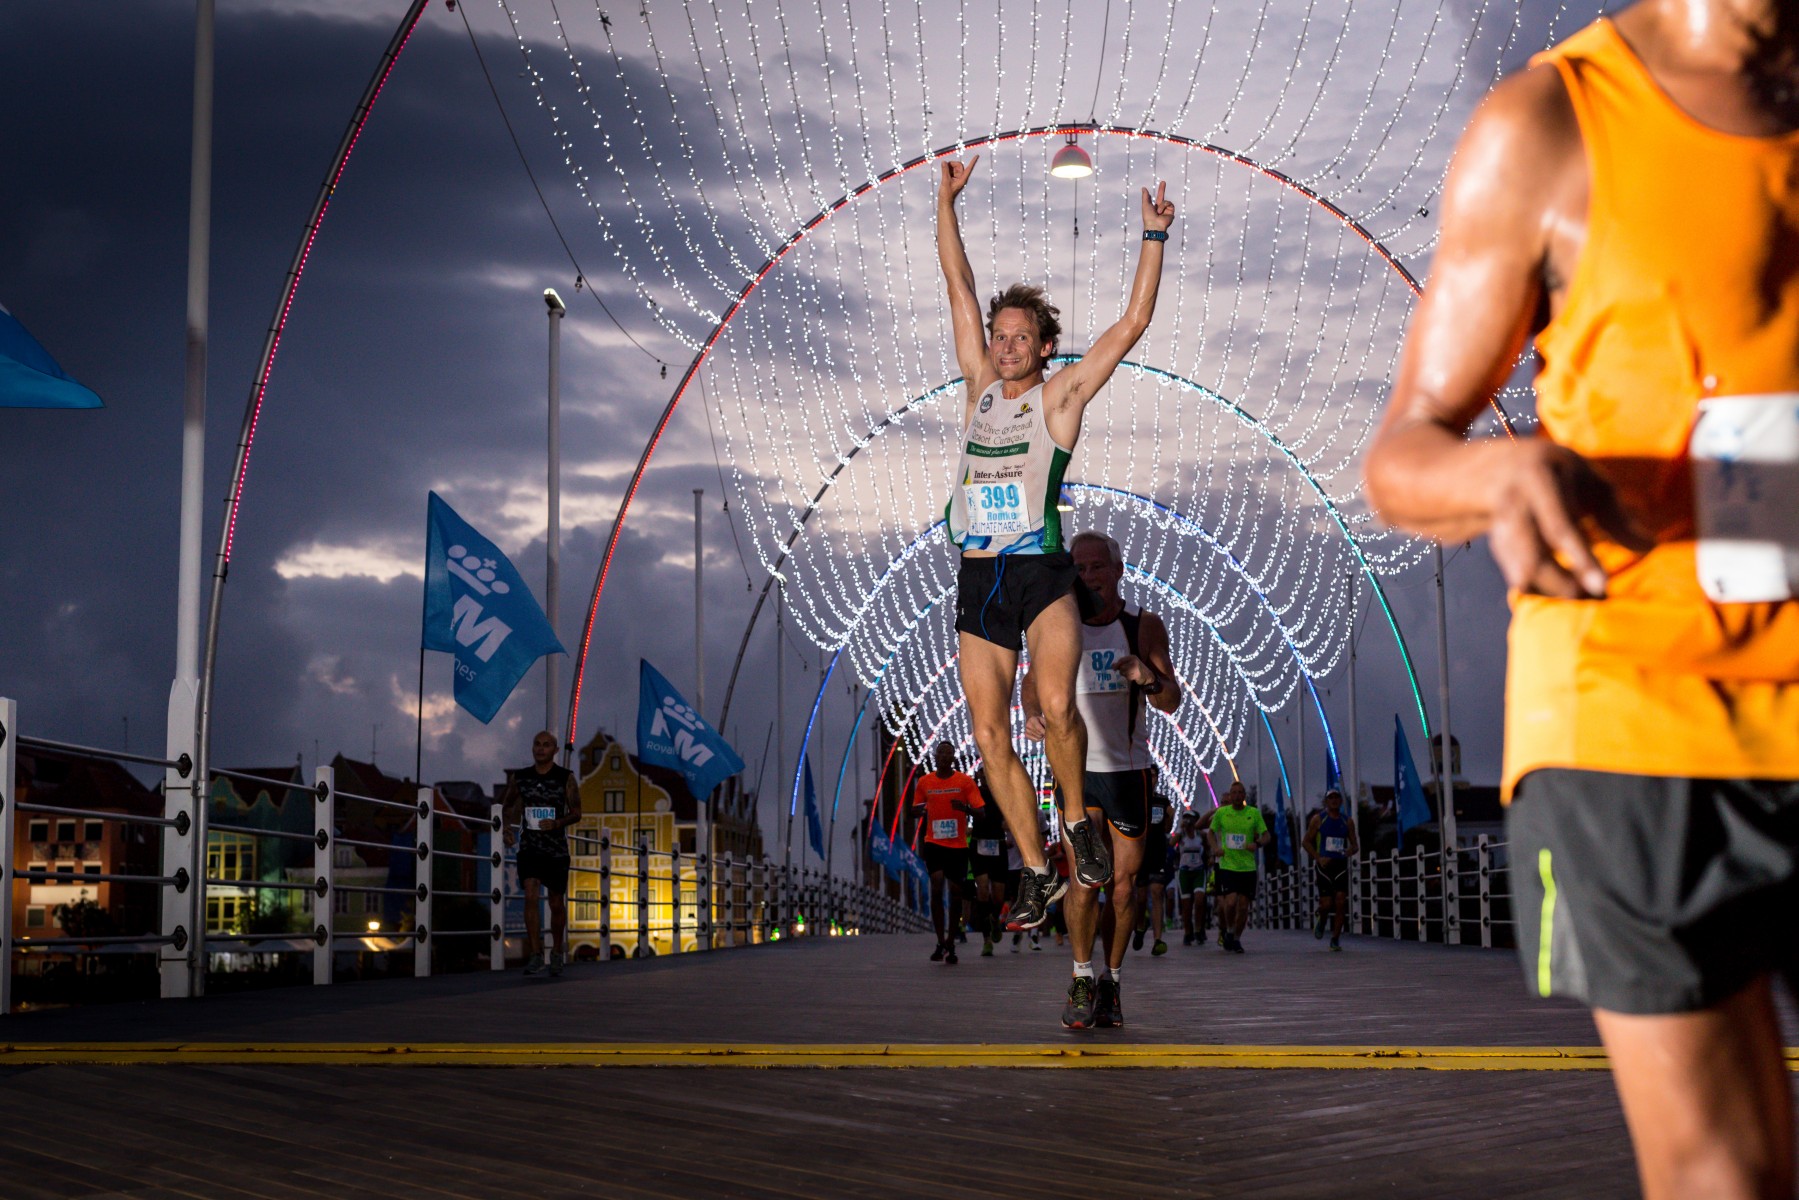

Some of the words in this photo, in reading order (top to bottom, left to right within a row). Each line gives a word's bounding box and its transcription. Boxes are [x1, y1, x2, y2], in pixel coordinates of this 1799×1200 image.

[984, 423, 1001, 435] Dive
[1010, 418, 1033, 433] Beach
[993, 434, 1025, 446] Curaçao
[974, 470, 1023, 479] Inter-Assure
[980, 484, 1020, 509] 399
[1091, 651, 1115, 671] 82
[532, 808, 554, 819] 1004
